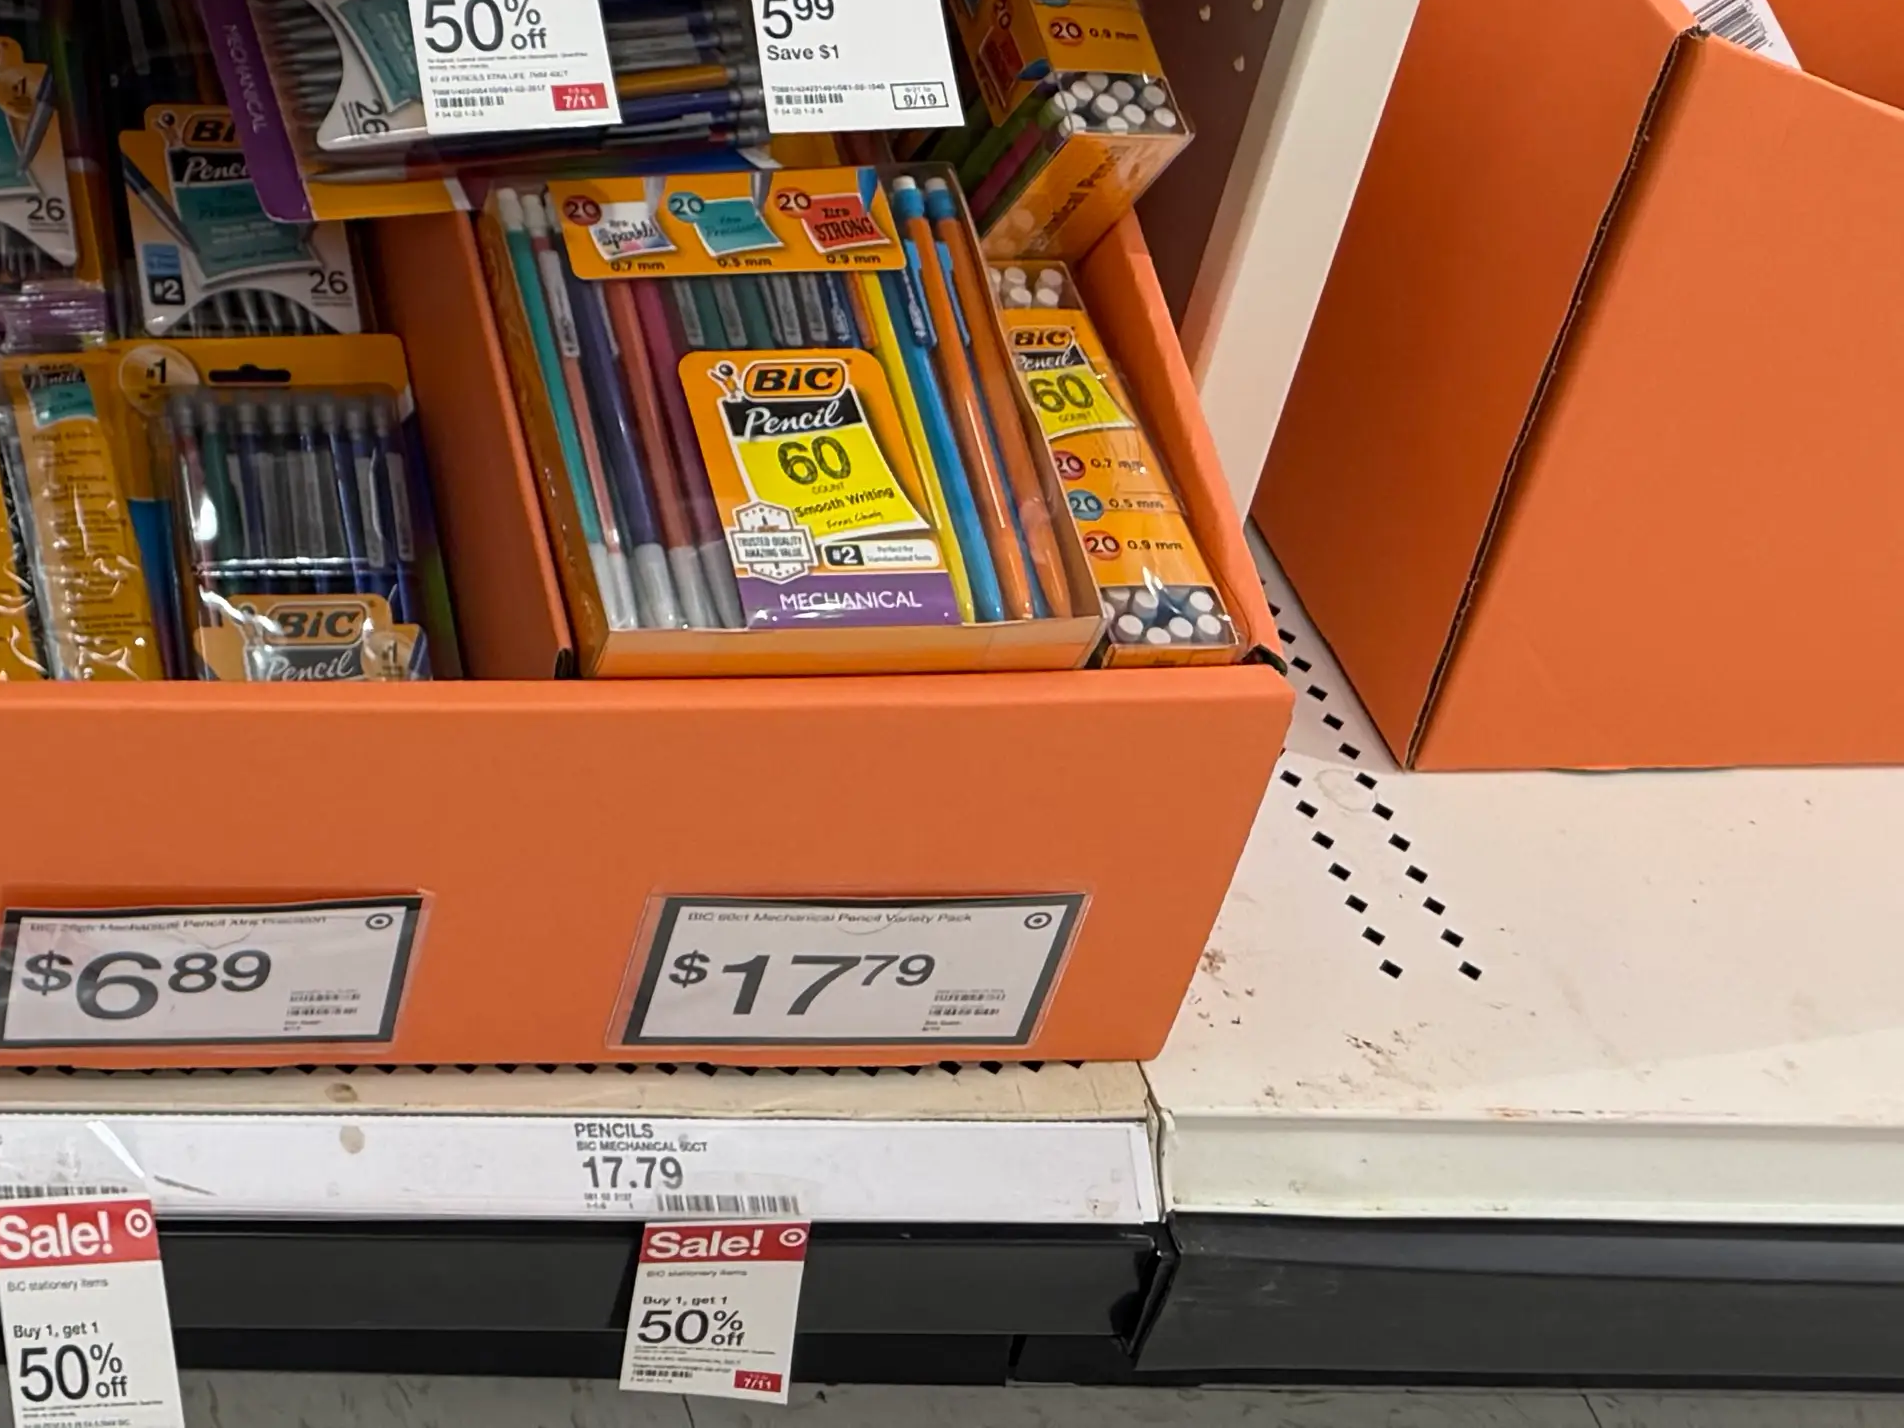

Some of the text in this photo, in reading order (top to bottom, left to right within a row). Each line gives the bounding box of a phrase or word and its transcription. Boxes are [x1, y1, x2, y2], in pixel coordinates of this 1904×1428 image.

[766, 44, 840, 61] Save $1
[743, 402, 845, 434] Pencil
[777, 435, 852, 486] 60
[779, 590, 923, 613] MECHANICAL
[582, 1155, 684, 1190] 17.79
